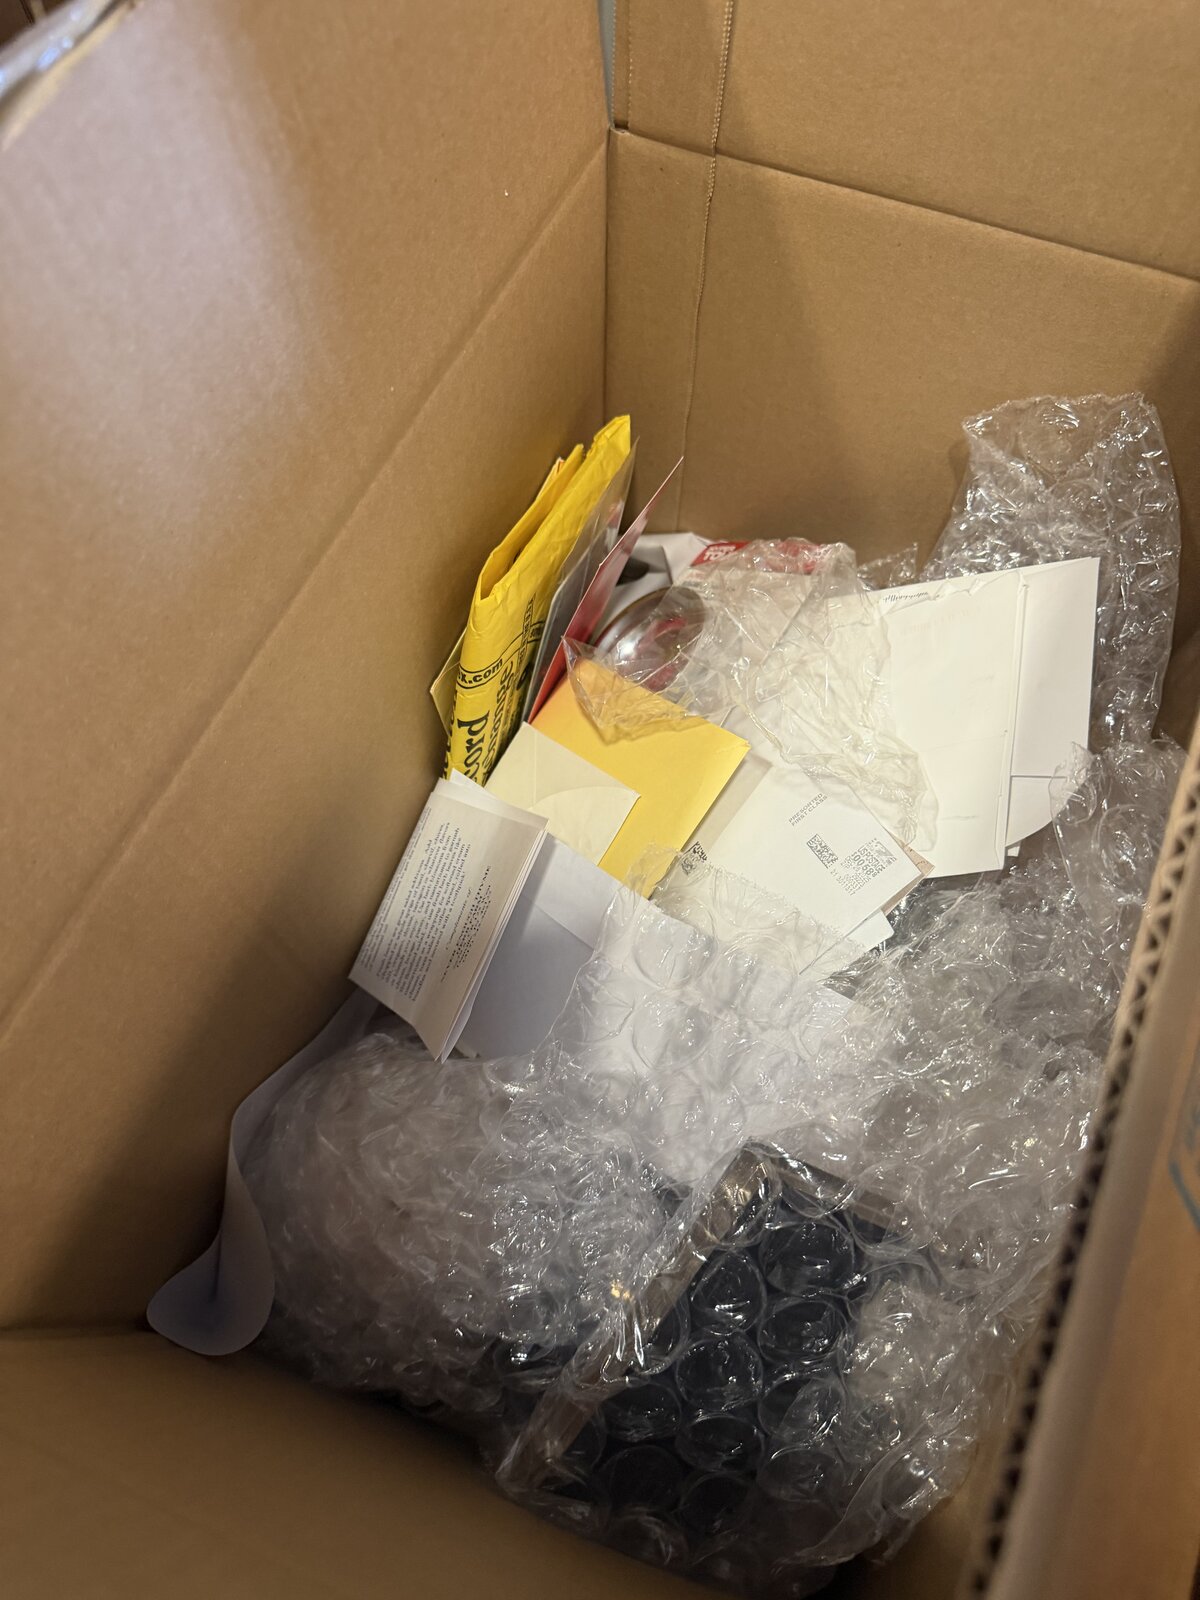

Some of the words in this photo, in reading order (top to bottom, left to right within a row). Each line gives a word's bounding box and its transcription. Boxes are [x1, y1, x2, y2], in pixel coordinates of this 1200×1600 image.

[457, 658, 504, 685] x.com
[481, 660, 514, 787] xchange
[457, 710, 490, 782] cord
[788, 792, 823, 822] PRESORTED
[791, 811, 808, 826] FIRST
[807, 794, 827, 812] CLASS
[862, 850, 885, 874] POSTAGE
